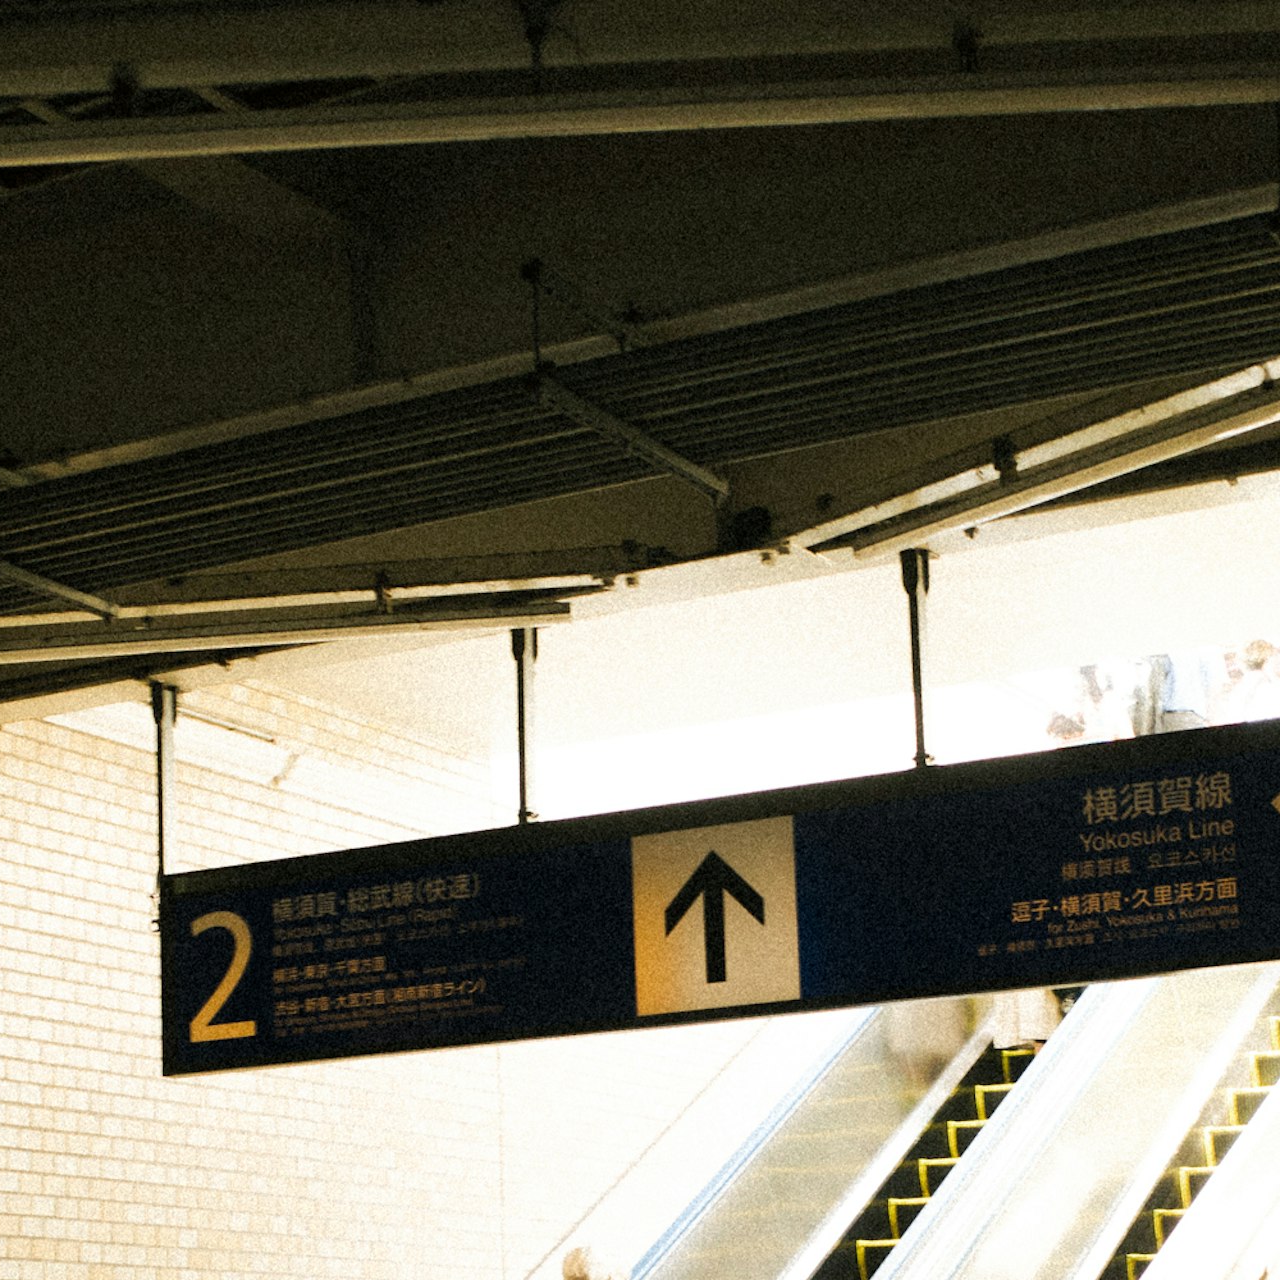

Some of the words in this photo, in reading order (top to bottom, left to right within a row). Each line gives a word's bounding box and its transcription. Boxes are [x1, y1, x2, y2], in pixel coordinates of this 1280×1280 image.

[1082, 772, 1233, 825] 横須賀線
[1079, 824, 1182, 853] Yokosuka
[1188, 818, 1235, 840] Line
[189, 910, 257, 1044] 2
